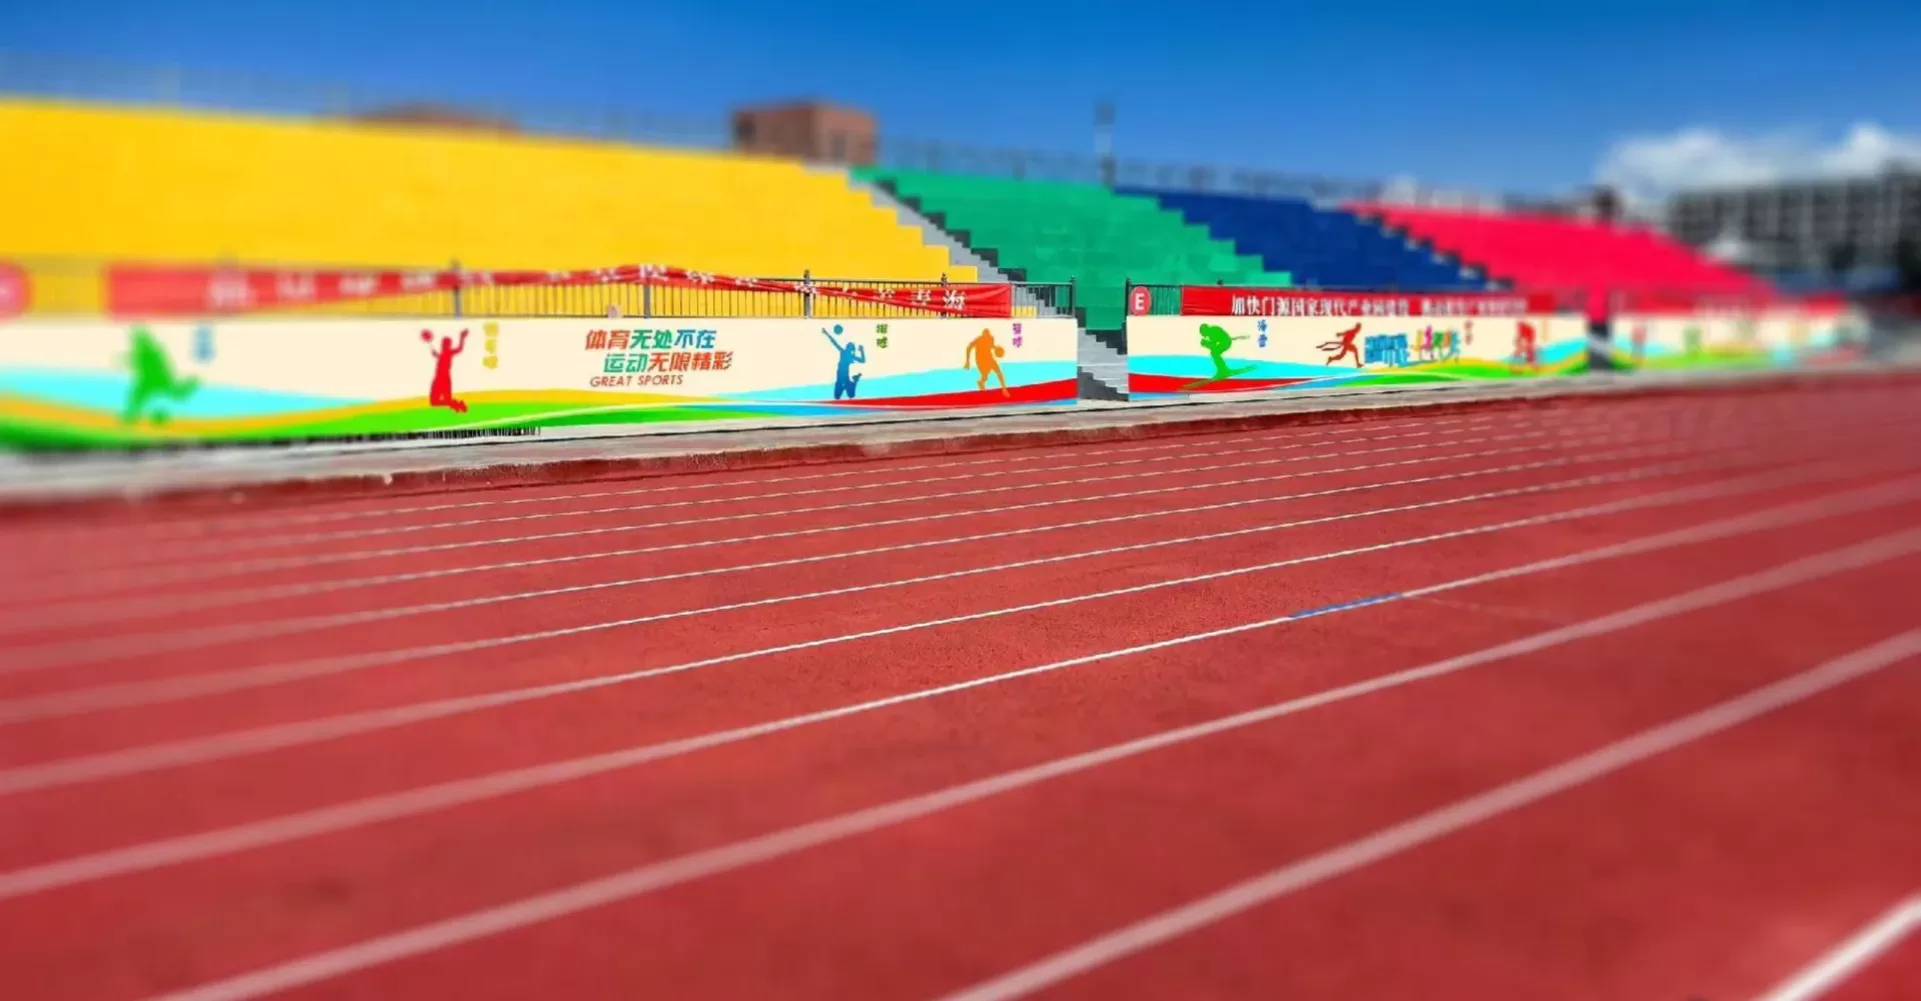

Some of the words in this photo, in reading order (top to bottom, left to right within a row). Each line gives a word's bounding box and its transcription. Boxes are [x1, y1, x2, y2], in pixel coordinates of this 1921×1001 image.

[1134, 293, 1145, 310] E
[585, 329, 717, 350] 体育无处不在
[603, 351, 734, 373] 运动无限精彩
[590, 376, 633, 387] GREAT
[637, 374, 684, 386] SPORTS
